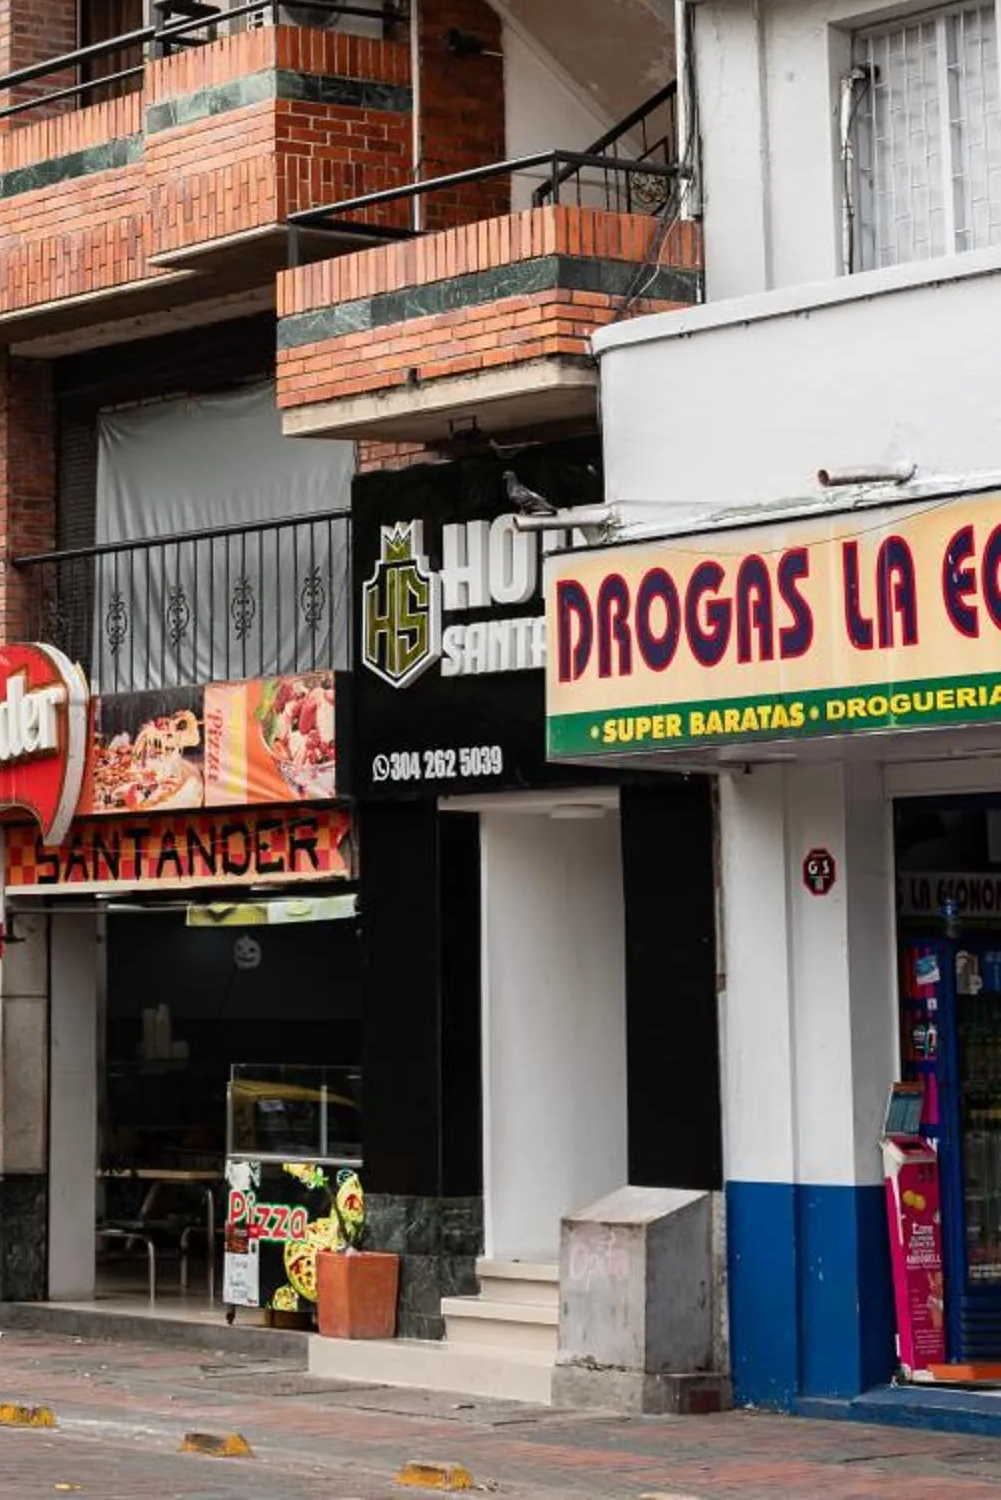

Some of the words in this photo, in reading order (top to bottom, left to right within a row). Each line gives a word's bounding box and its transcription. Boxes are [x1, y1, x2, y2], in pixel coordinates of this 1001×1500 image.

[556, 546, 814, 684] DROGAS
[842, 534, 920, 651] LA
[602, 716, 683, 744] SUPER
[689, 701, 806, 737] BARATAS
[390, 751, 420, 780] 304
[423, 748, 456, 779] 262
[459, 745, 503, 776] 5039
[35, 817, 319, 886] SANTANDER
[228, 1189, 308, 1242] Pizza
